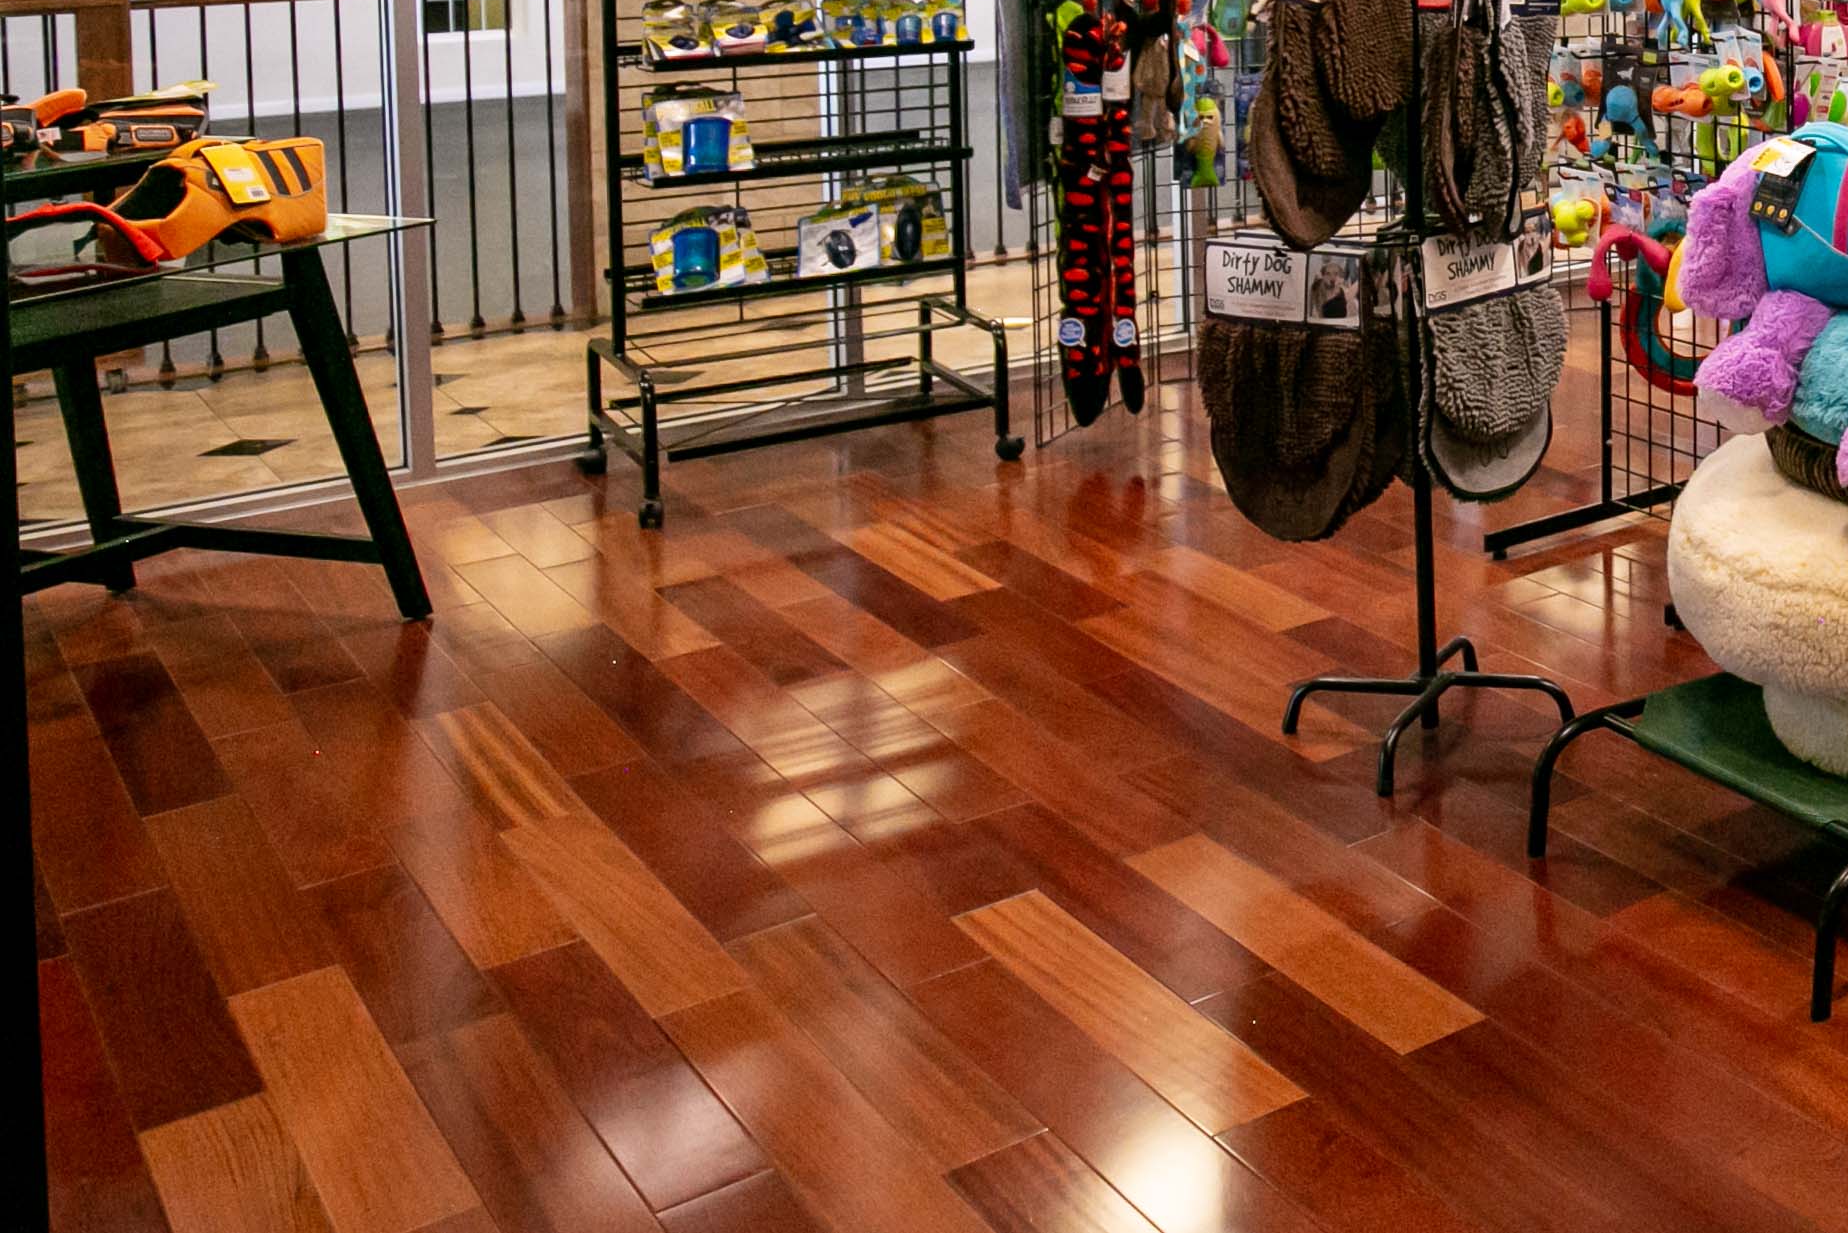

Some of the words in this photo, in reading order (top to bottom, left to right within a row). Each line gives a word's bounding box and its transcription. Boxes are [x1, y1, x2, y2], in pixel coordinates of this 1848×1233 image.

[1437, 237, 1471, 258] Dirty
[1222, 250, 1259, 276] Dirty
[1447, 250, 1495, 281] SHAMMY
[1227, 276, 1284, 299] SHAMMY
